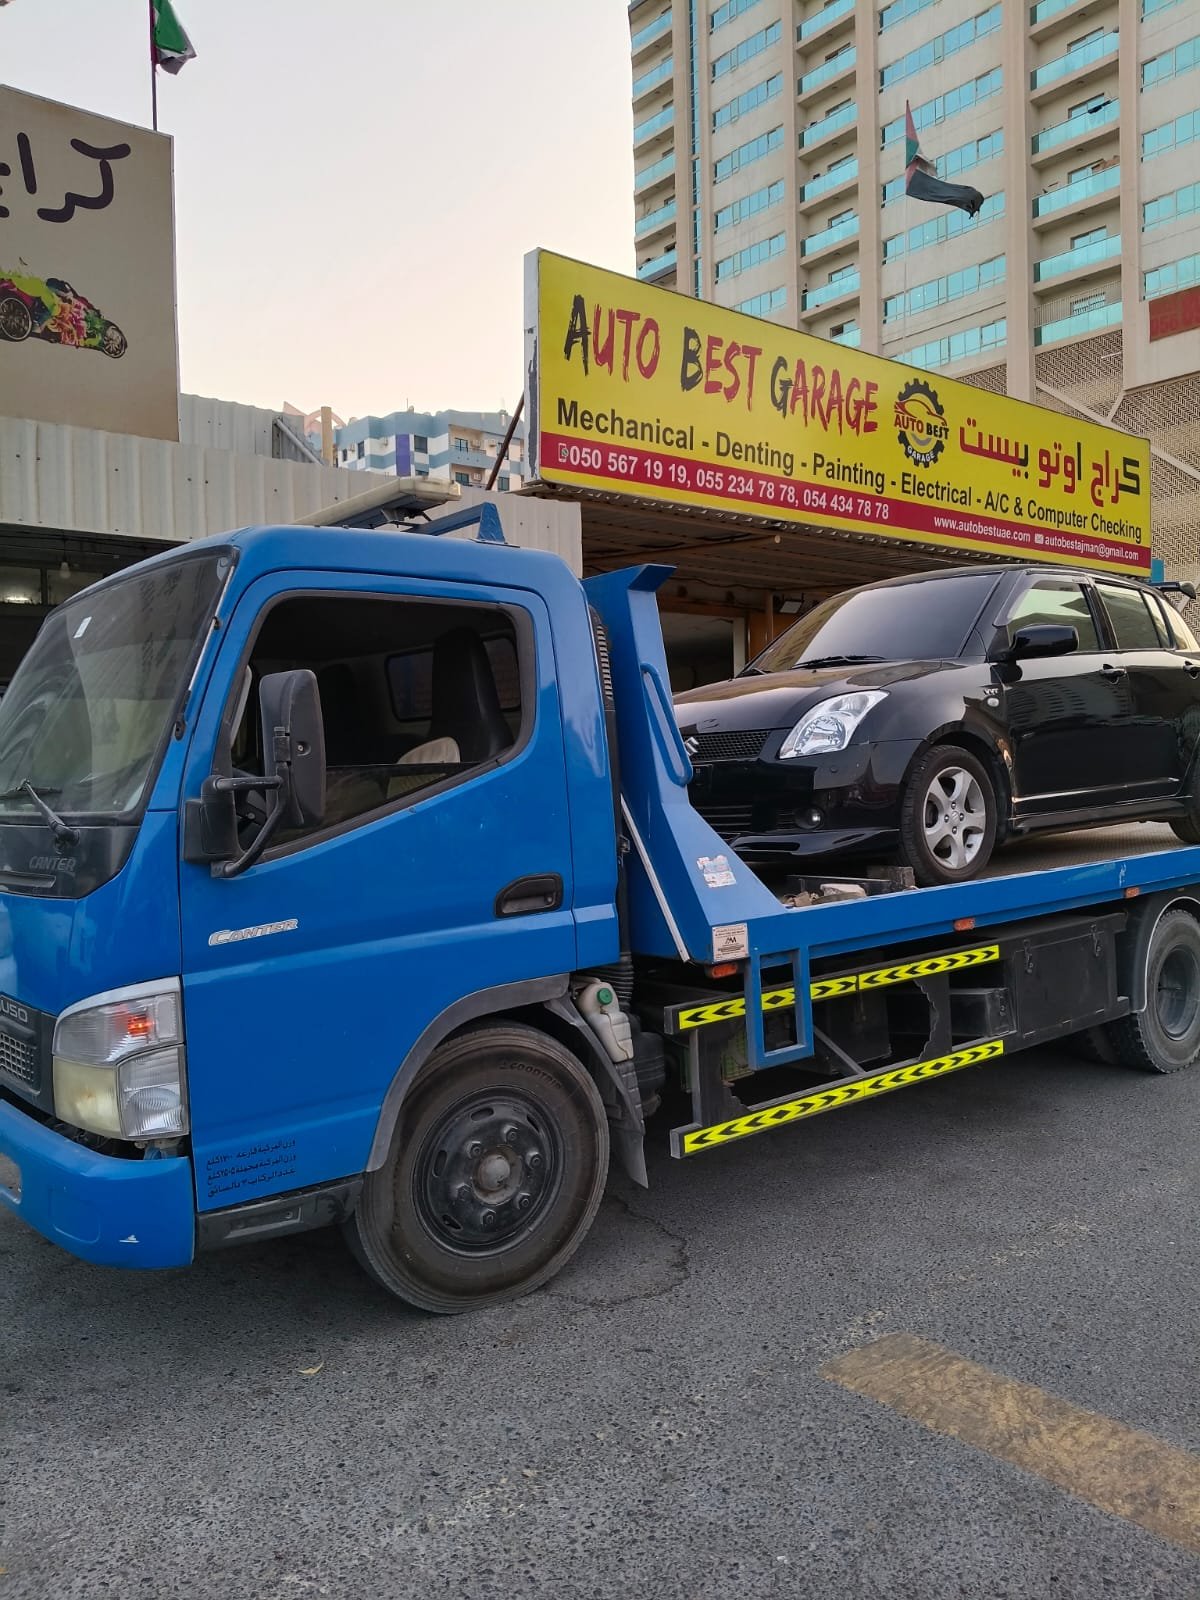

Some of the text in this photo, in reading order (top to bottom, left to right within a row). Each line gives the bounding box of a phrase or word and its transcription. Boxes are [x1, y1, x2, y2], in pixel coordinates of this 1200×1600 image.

[0, 131, 131, 223] كرا
[563, 294, 879, 437] AUTO BEST GARAGE
[894, 414, 949, 440] AUTO BEST
[907, 445, 935, 462] GARAGE
[959, 417, 1141, 507] كراج اوتو بيست
[557, 398, 694, 451] Mechanical
[716, 431, 794, 476] Denting
[813, 452, 885, 494] Painting
[901, 472, 972, 507] Electrical
[985, 491, 1009, 514] A/C
[1014, 500, 1024, 516] &
[1028, 503, 1088, 530] Computer
[1091, 513, 1142, 544] Checking
[570, 446, 889, 520] 050 567 19 19, 055 234 78 78, 054 434 78 78
[934, 515, 1031, 543] www.autobestuae.com
[1045, 535, 1139, 562] autobestajman@gmail.com
[29, 856, 77, 873] CANTER
[208, 918, 299, 946] CANTER
[0, 1000, 28, 1023] USO
